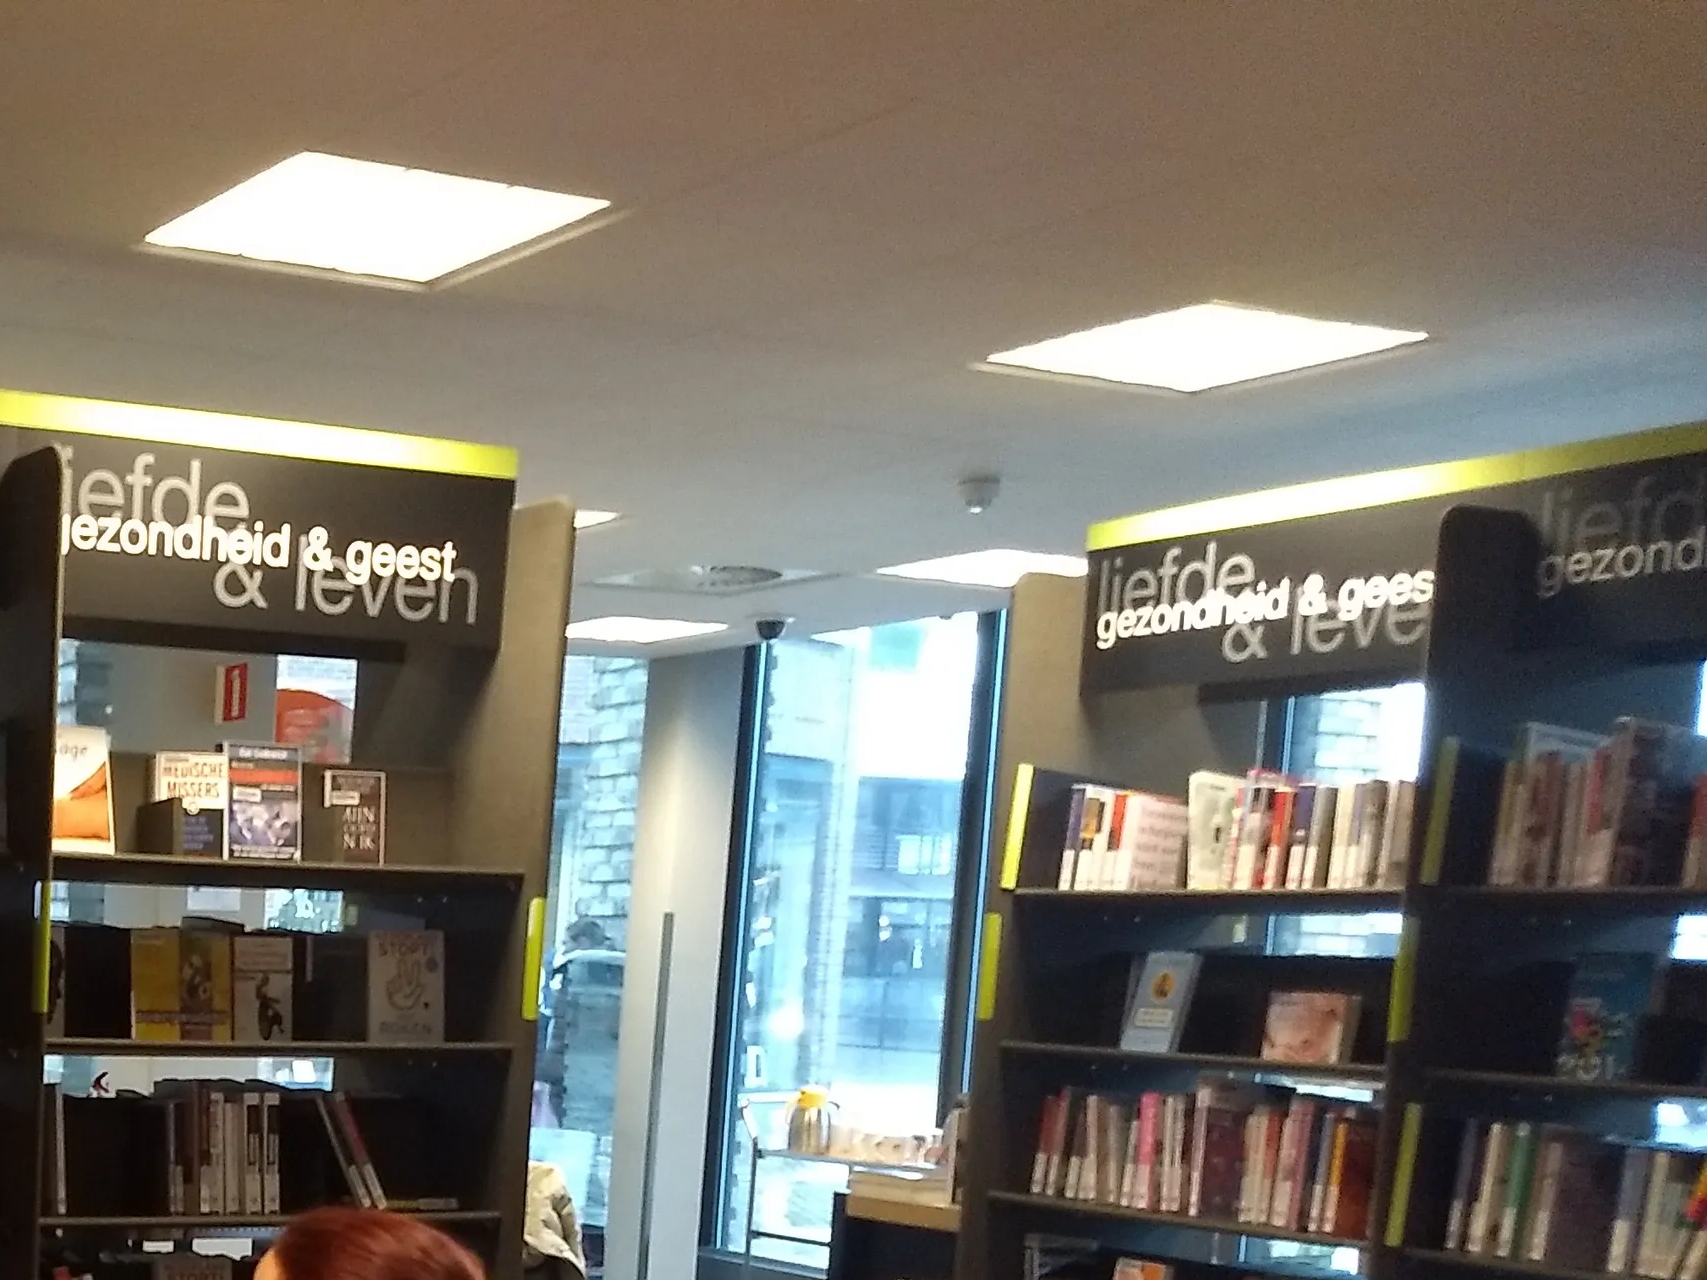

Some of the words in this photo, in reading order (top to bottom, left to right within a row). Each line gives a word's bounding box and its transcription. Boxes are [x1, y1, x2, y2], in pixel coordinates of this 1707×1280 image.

[60, 446, 250, 528] iefde
[214, 556, 268, 609] &
[295, 534, 478, 625] leven
[303, 526, 334, 571] &
[346, 538, 456, 585] geest
[1097, 541, 1256, 614] liefde
[1096, 577, 1290, 649] gezondheid
[1298, 574, 1328, 616] &
[1338, 568, 1435, 620] gees
[1290, 584, 1428, 655] leve
[167, 782, 221, 798] MISSERS
